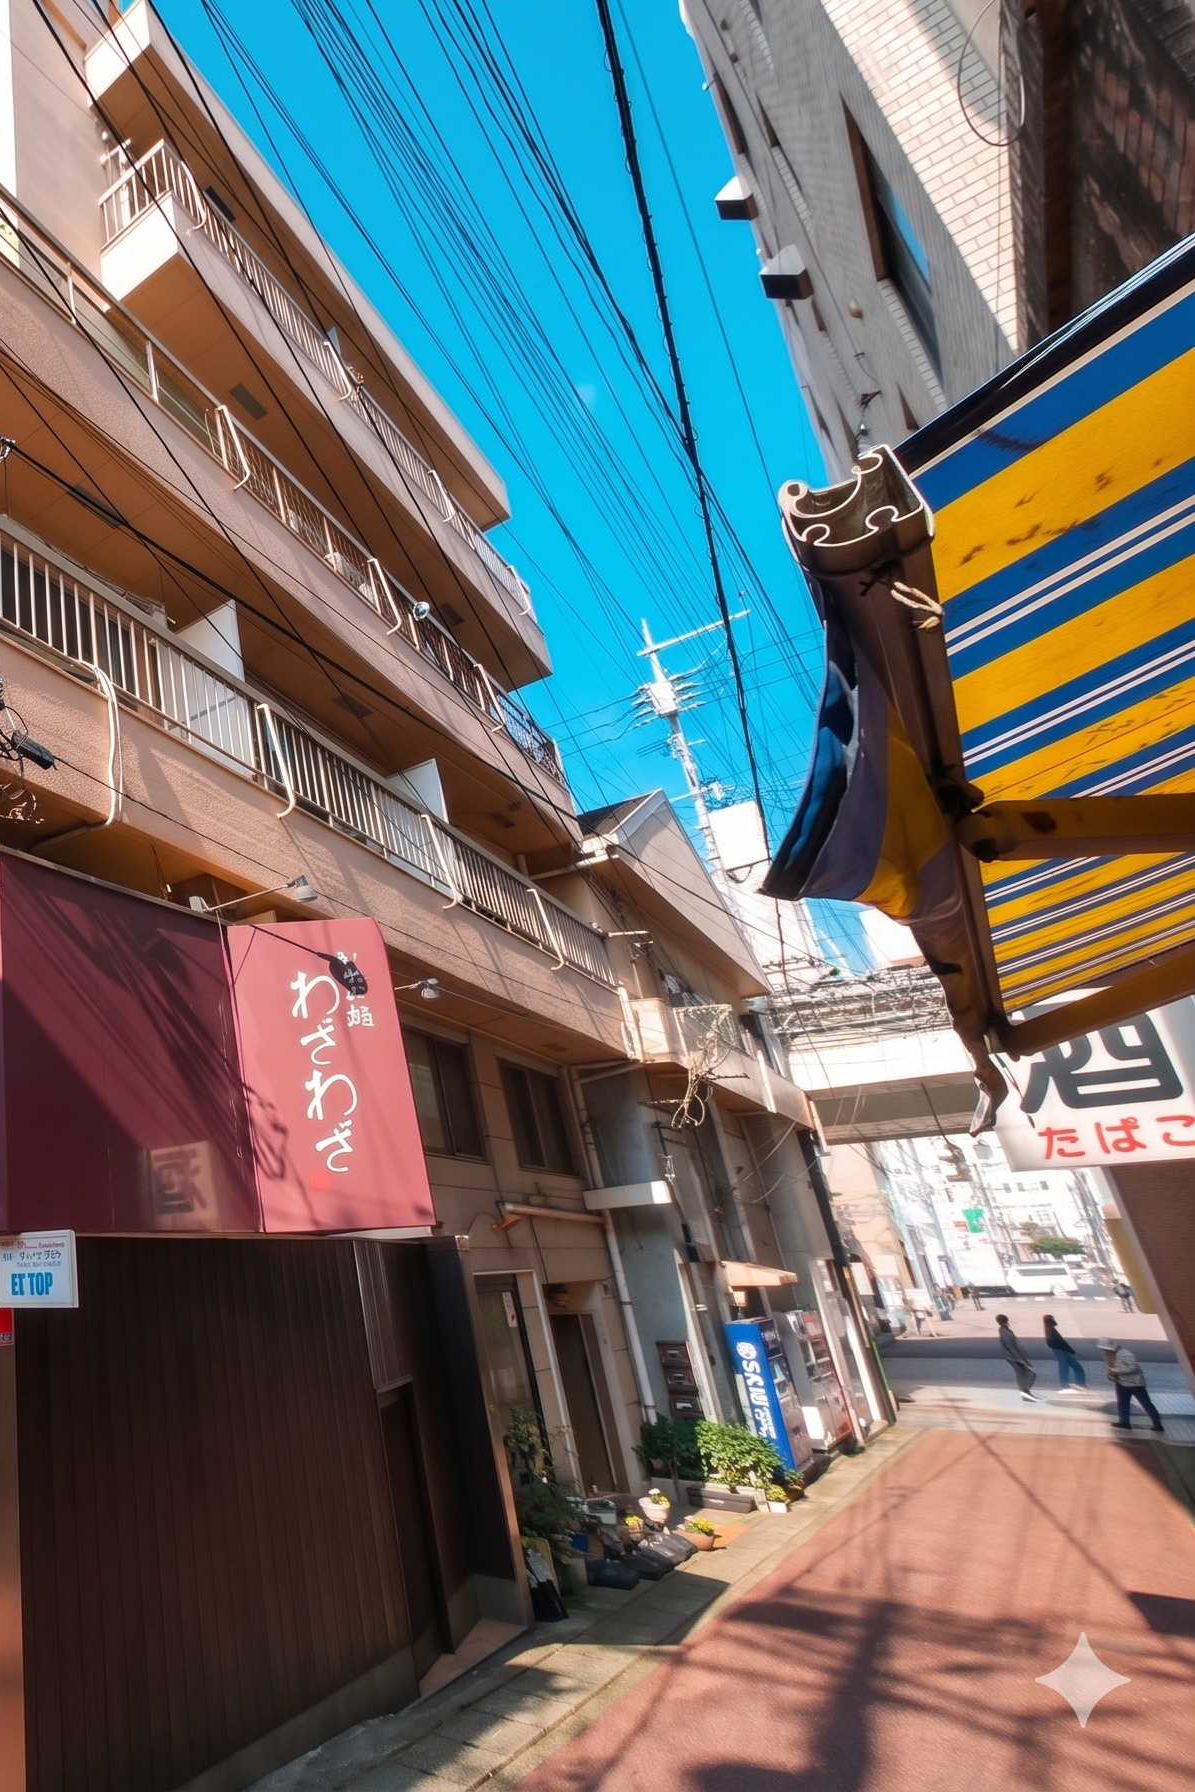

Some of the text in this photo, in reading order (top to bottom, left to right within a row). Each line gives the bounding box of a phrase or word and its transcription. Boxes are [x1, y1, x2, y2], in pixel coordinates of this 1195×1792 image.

[290, 970, 358, 1172] わざわざ
[27, 1271, 54, 1296] TOP
